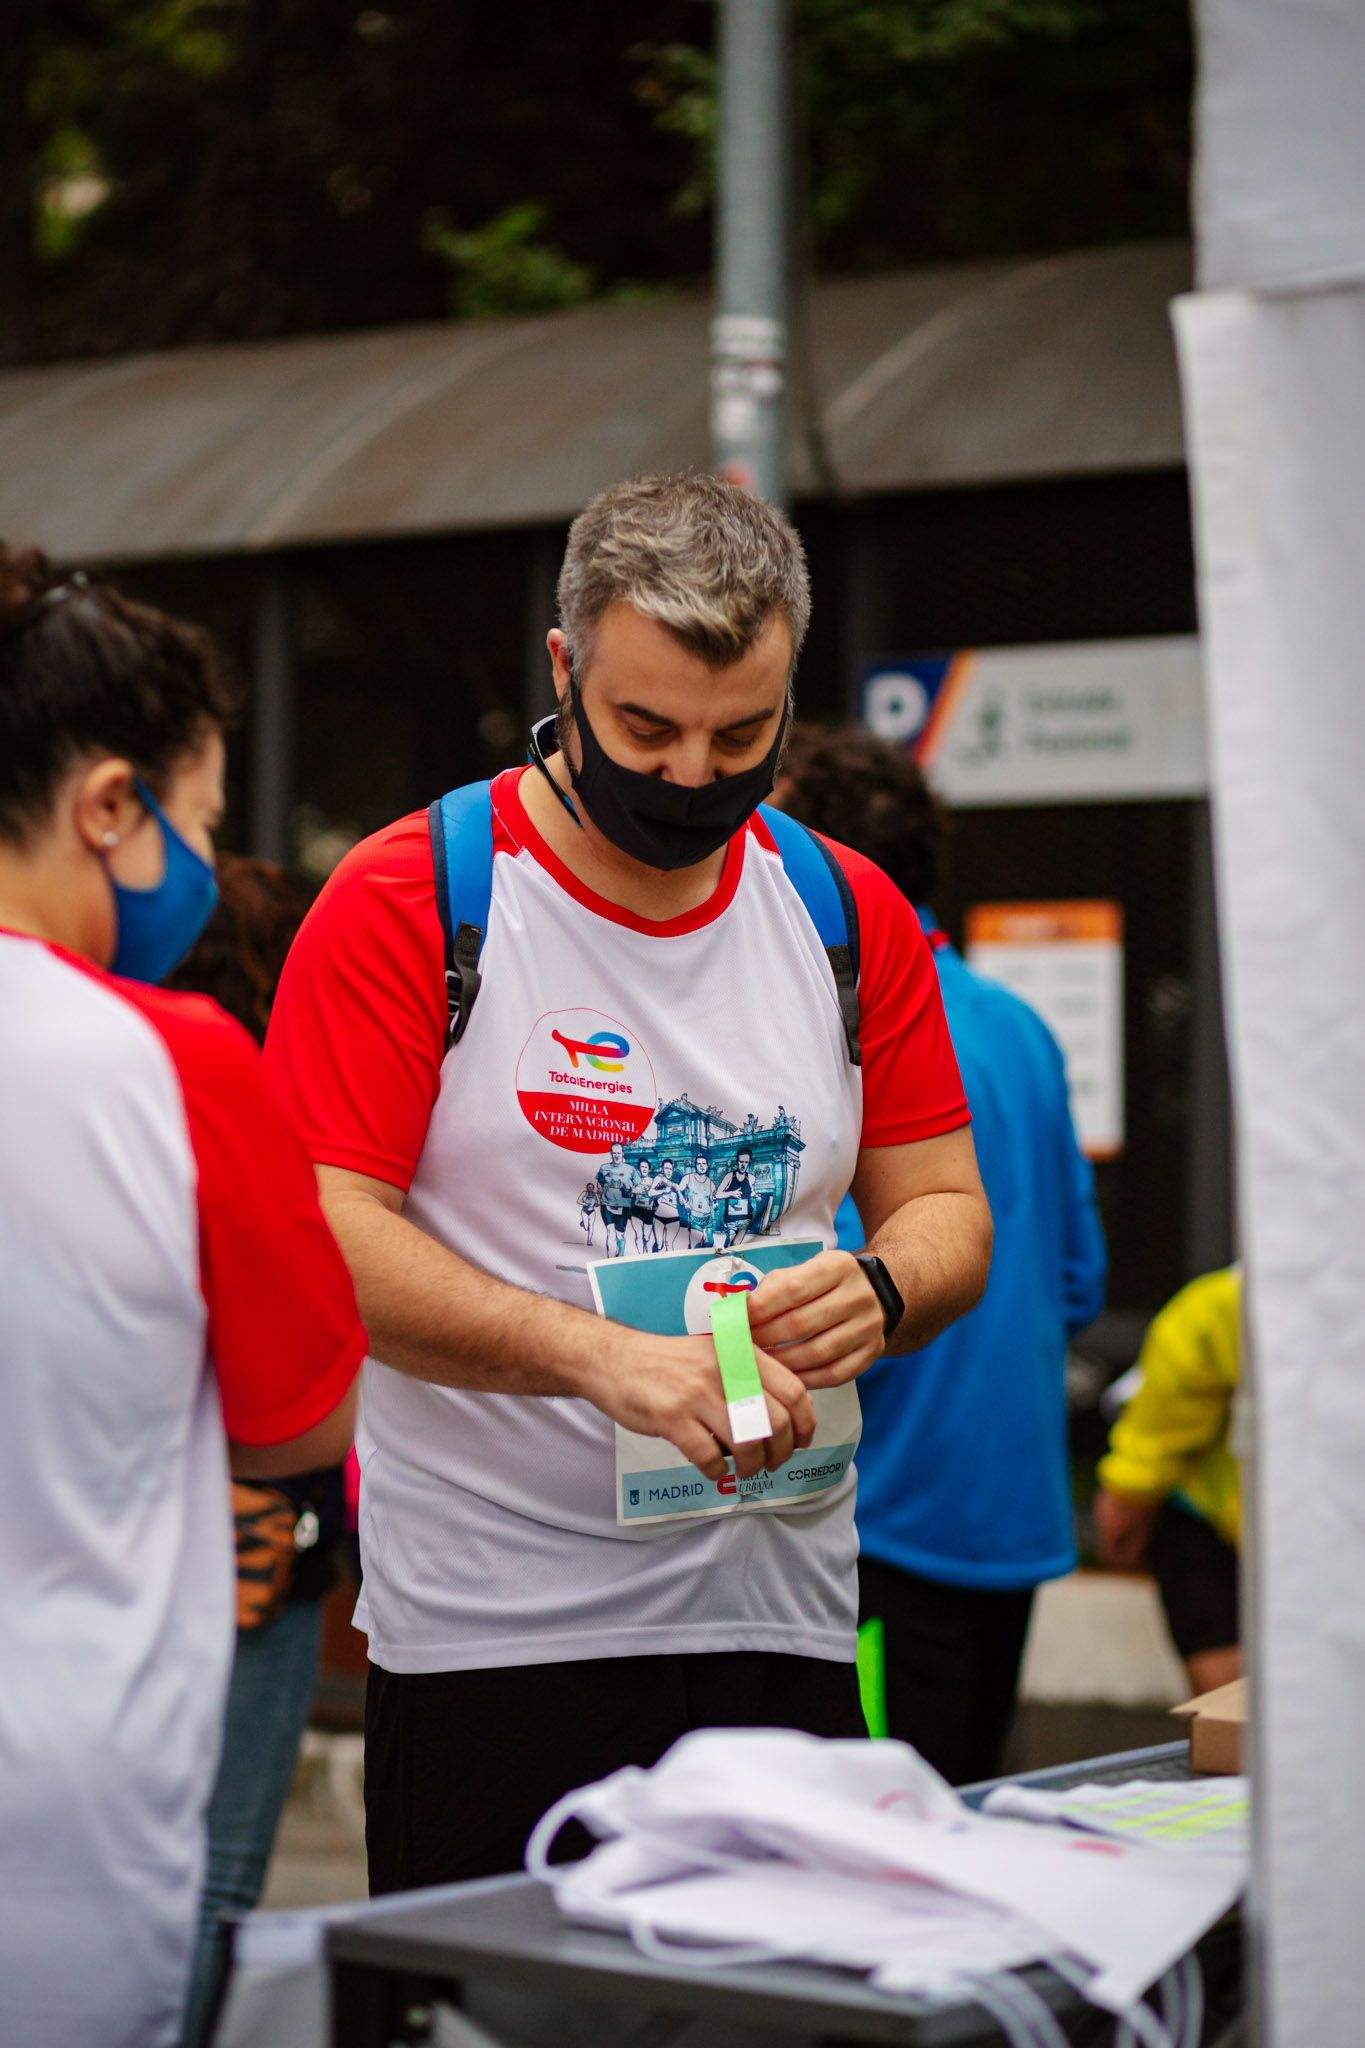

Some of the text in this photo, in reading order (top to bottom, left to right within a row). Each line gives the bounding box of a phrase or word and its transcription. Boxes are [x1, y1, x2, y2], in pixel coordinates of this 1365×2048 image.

[548, 1071, 633, 1094] TotalEnergies
[569, 1100, 609, 1115] MILLA
[550, 1126, 569, 1137] DE
[648, 1483, 704, 1501] MADRID
